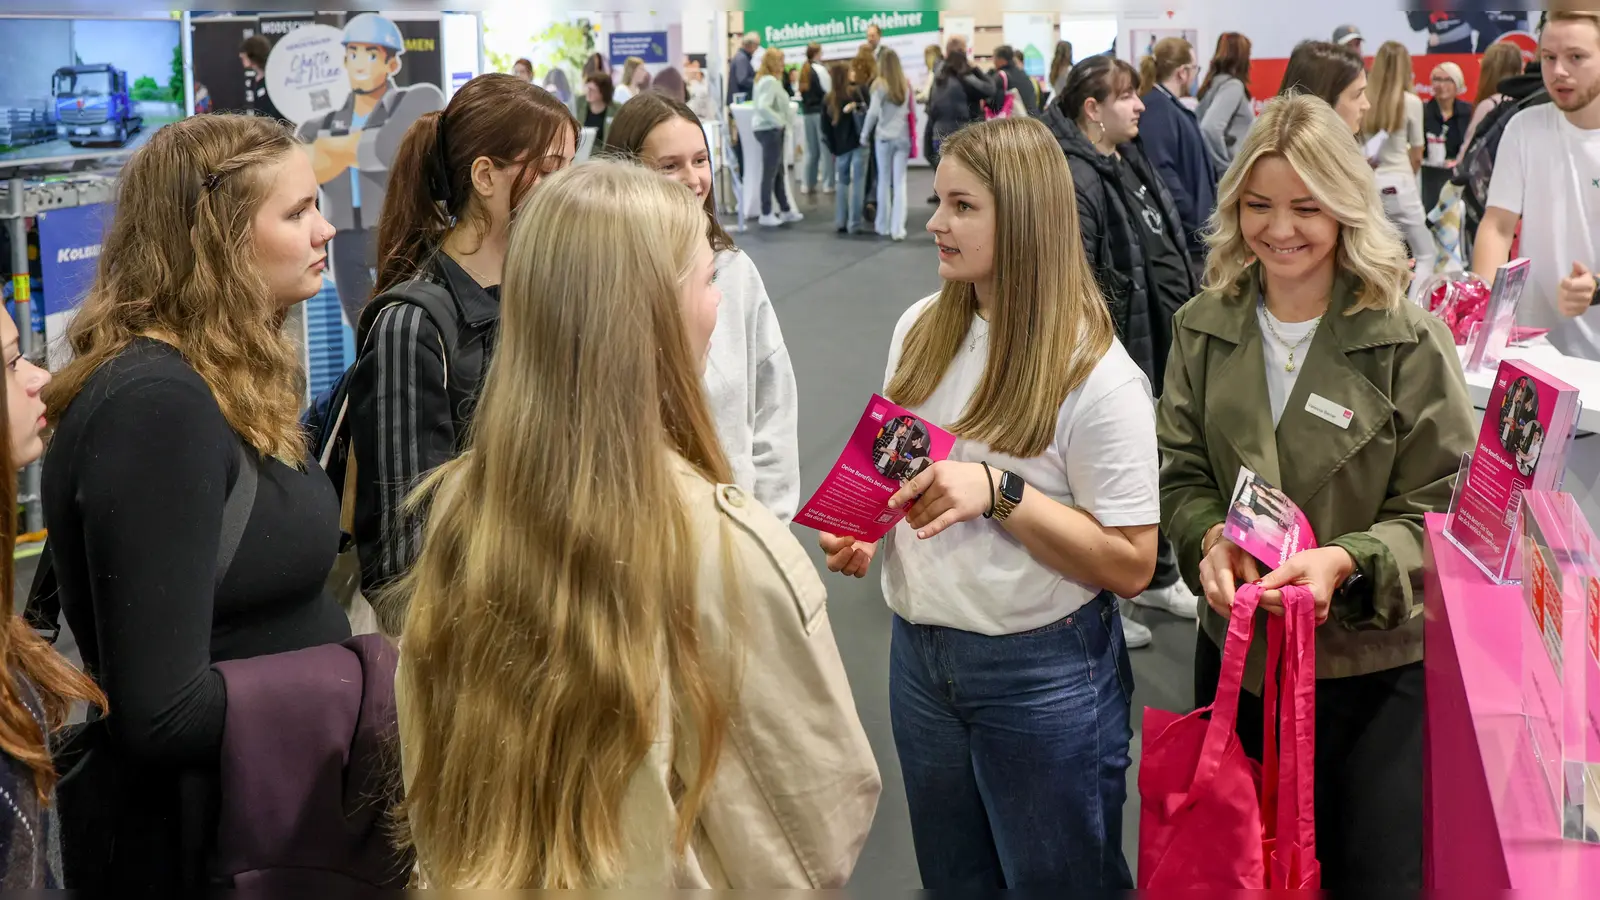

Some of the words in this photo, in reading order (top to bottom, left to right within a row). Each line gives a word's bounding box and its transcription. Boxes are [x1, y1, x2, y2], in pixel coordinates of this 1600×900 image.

[765, 19, 845, 42] Fachlehrerin
[852, 11, 923, 30] Fachlehrer
[404, 38, 435, 51] MEN
[841, 463, 856, 474] Deine
[855, 470, 875, 484] Benefits
[874, 480, 883, 488] bei
[881, 484, 895, 494] medi
